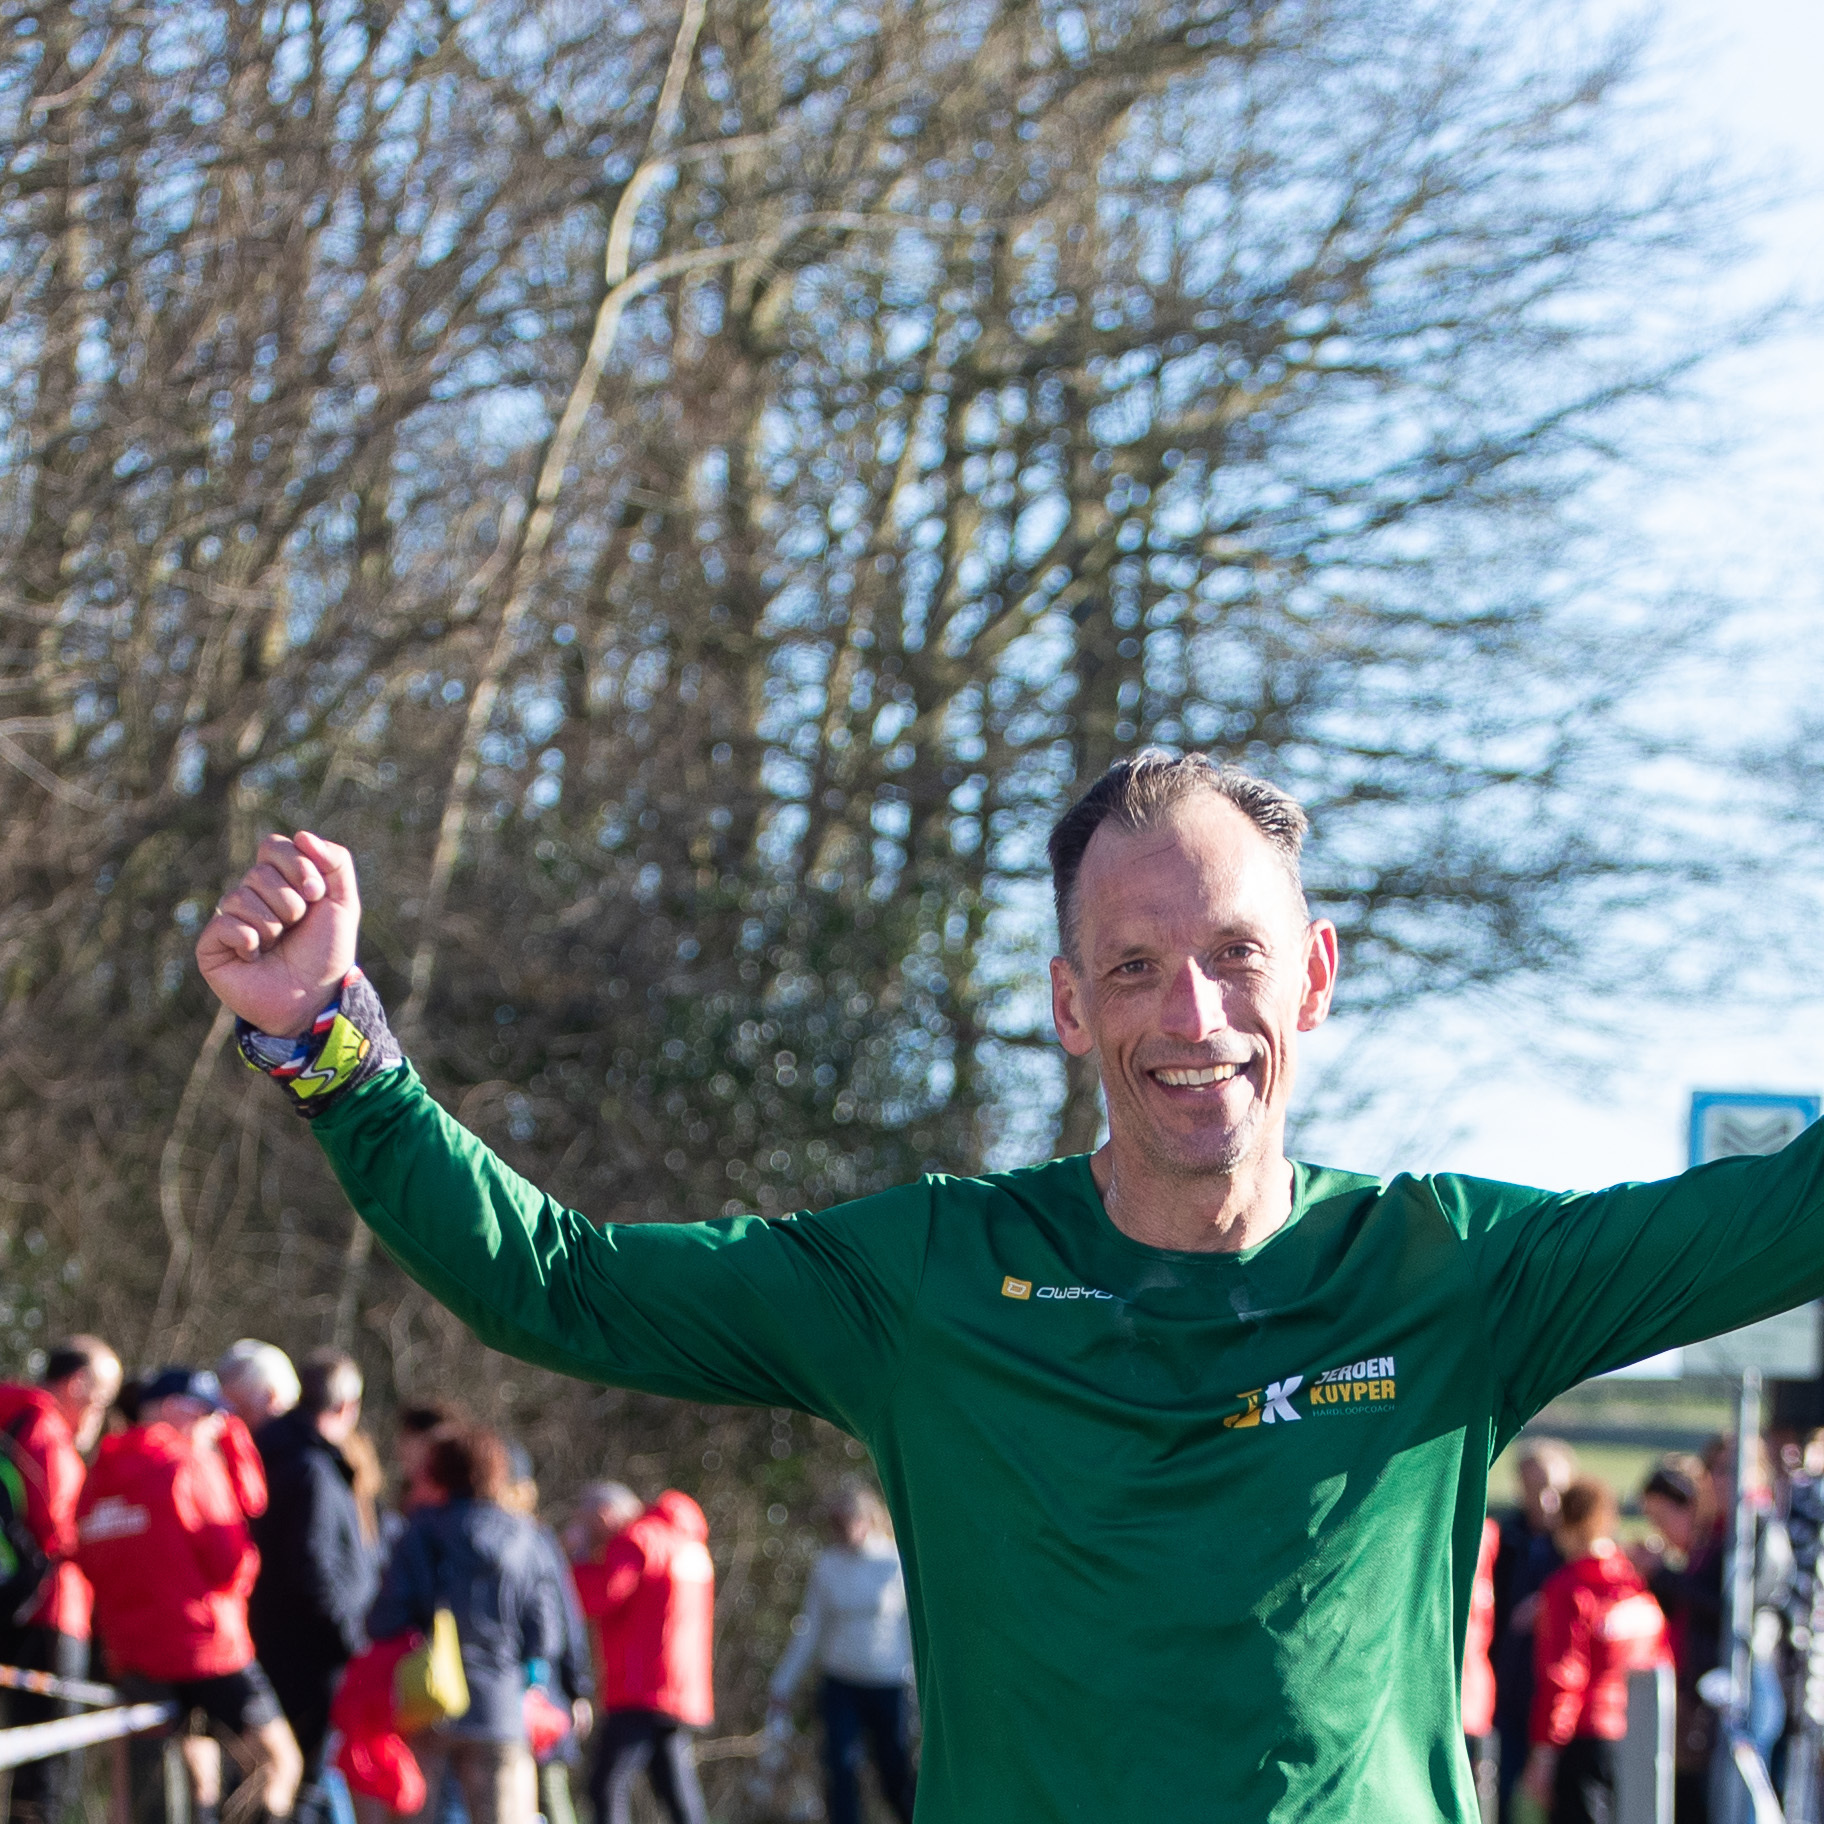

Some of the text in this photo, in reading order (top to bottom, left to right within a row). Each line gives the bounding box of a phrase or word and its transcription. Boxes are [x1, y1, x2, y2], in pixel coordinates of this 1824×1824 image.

[1314, 1356, 1396, 1386] JEROEN
[1309, 1379, 1396, 1405] KUYPER
[1312, 1404, 1395, 1417] HARDLOOPCOACH
